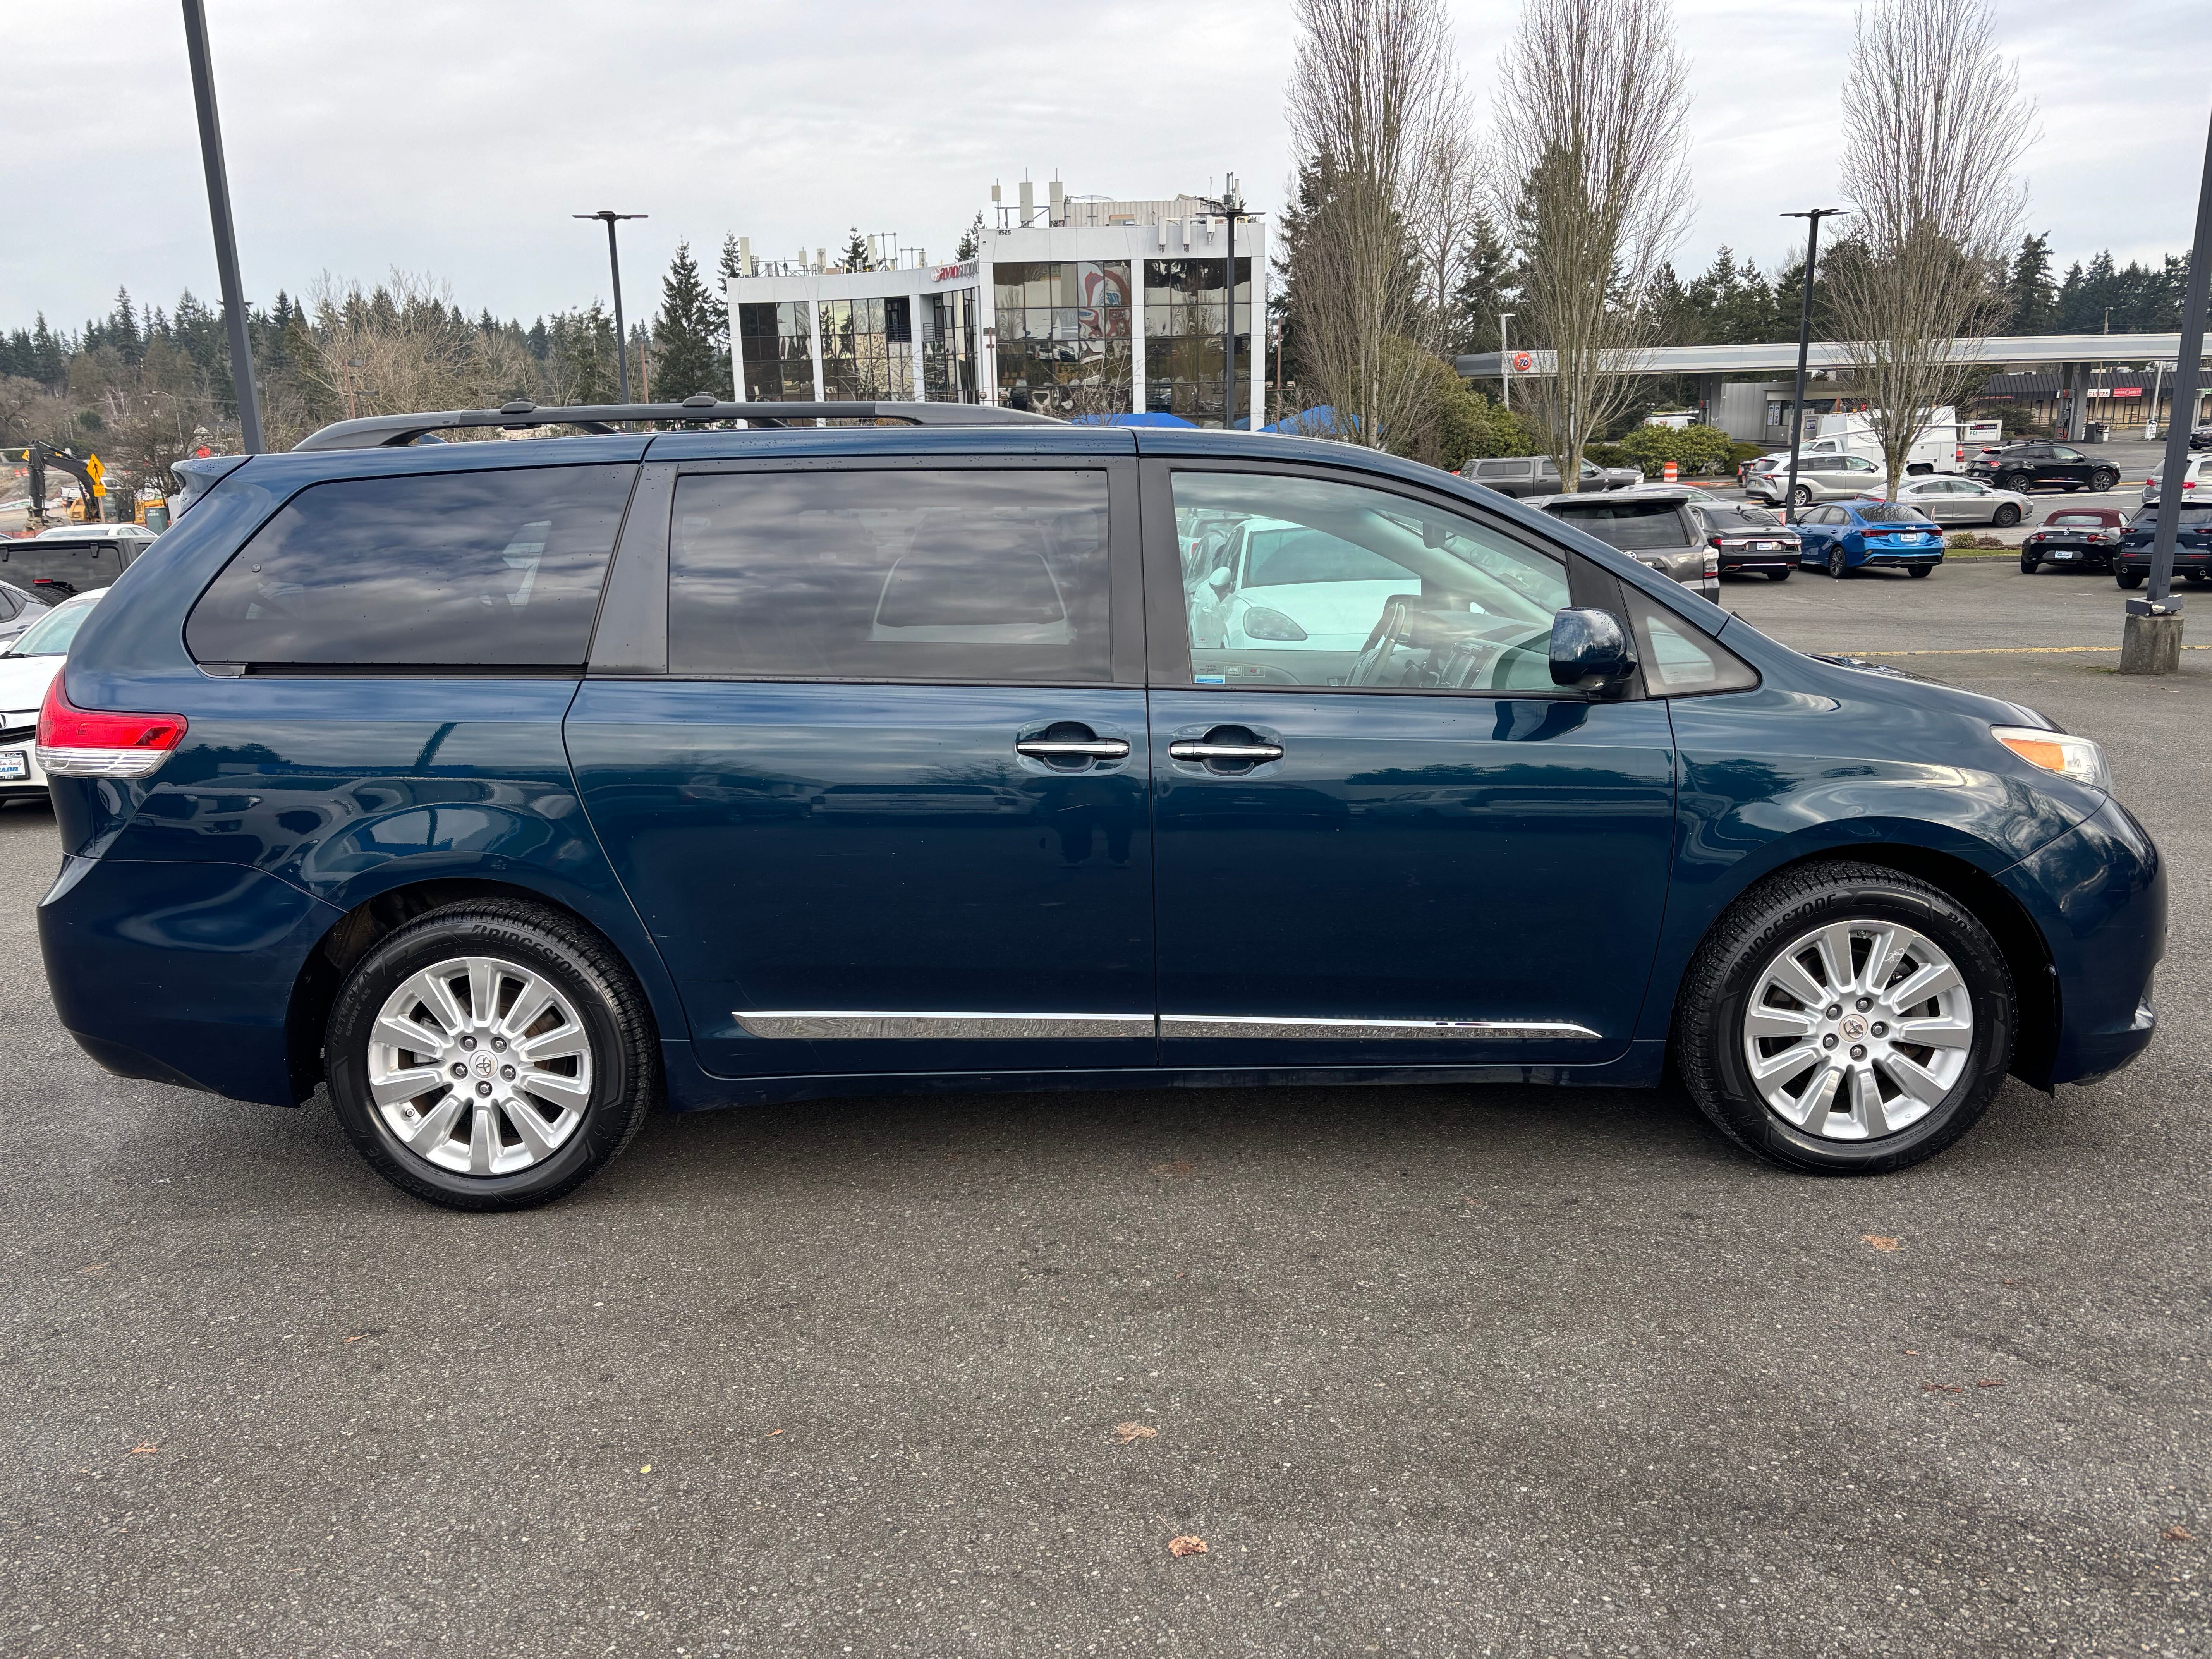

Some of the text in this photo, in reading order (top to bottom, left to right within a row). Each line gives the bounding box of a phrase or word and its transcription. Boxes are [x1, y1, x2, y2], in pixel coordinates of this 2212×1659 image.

[1518, 358, 1529, 367] 76
[471, 924, 591, 991] BRIDGESTONE
[1729, 892, 1838, 979] BRIDGESTONE
[1949, 929, 1987, 972] SPORT AS
[345, 988, 372, 1037] SPORT AS
